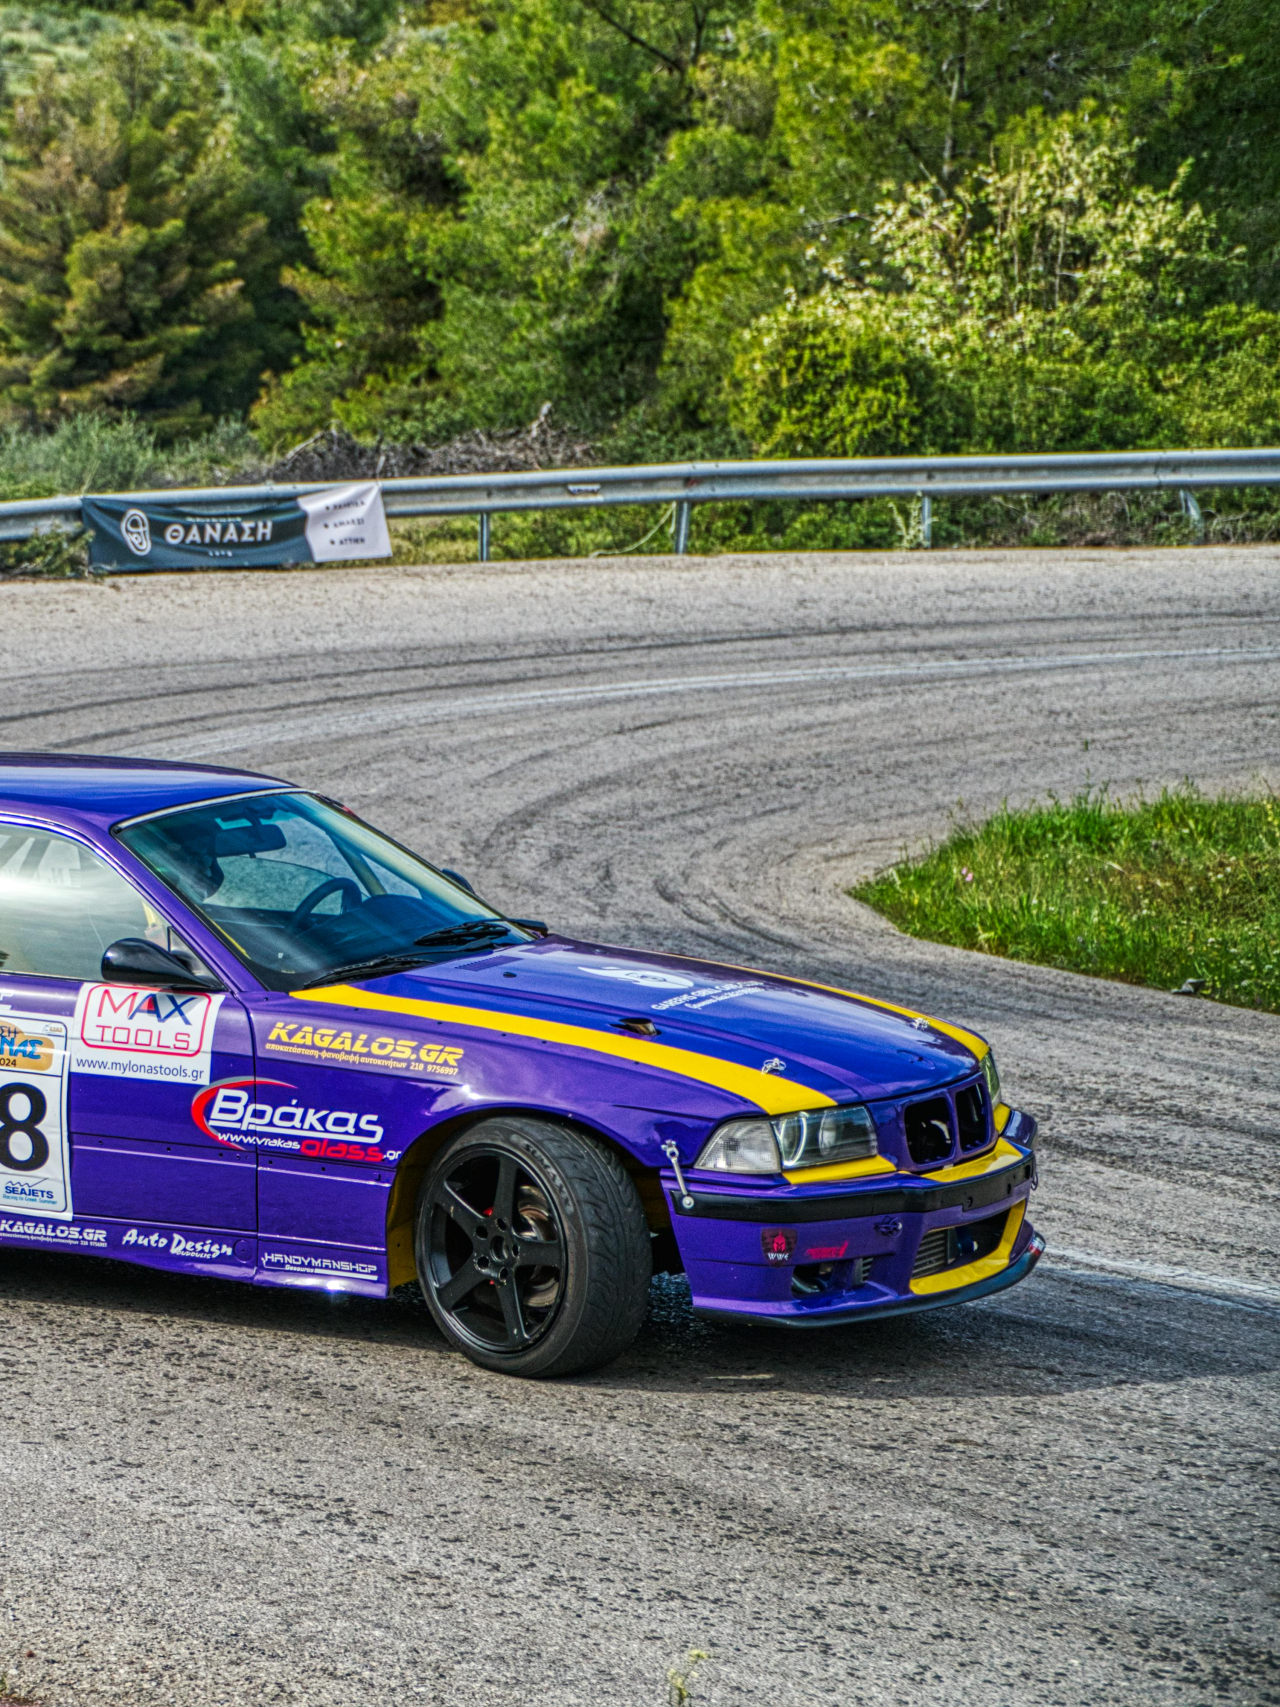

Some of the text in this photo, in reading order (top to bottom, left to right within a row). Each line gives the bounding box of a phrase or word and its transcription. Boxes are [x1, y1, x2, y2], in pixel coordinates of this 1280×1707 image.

[164, 520, 273, 545] ΘΑΝΑΣΗ
[97, 989, 197, 1026] MAX
[96, 1025, 191, 1050] TOOLS
[268, 1022, 464, 1066] KAGALOS.GR
[76, 1056, 204, 1081] www.mylonastools.gr
[4, 1185, 54, 1199] SEAJETS
[0, 1219, 107, 1241] KAGALOS.GR
[122, 1228, 233, 1258] Auto Design
[263, 1252, 377, 1273] HANDYMANSHOP
